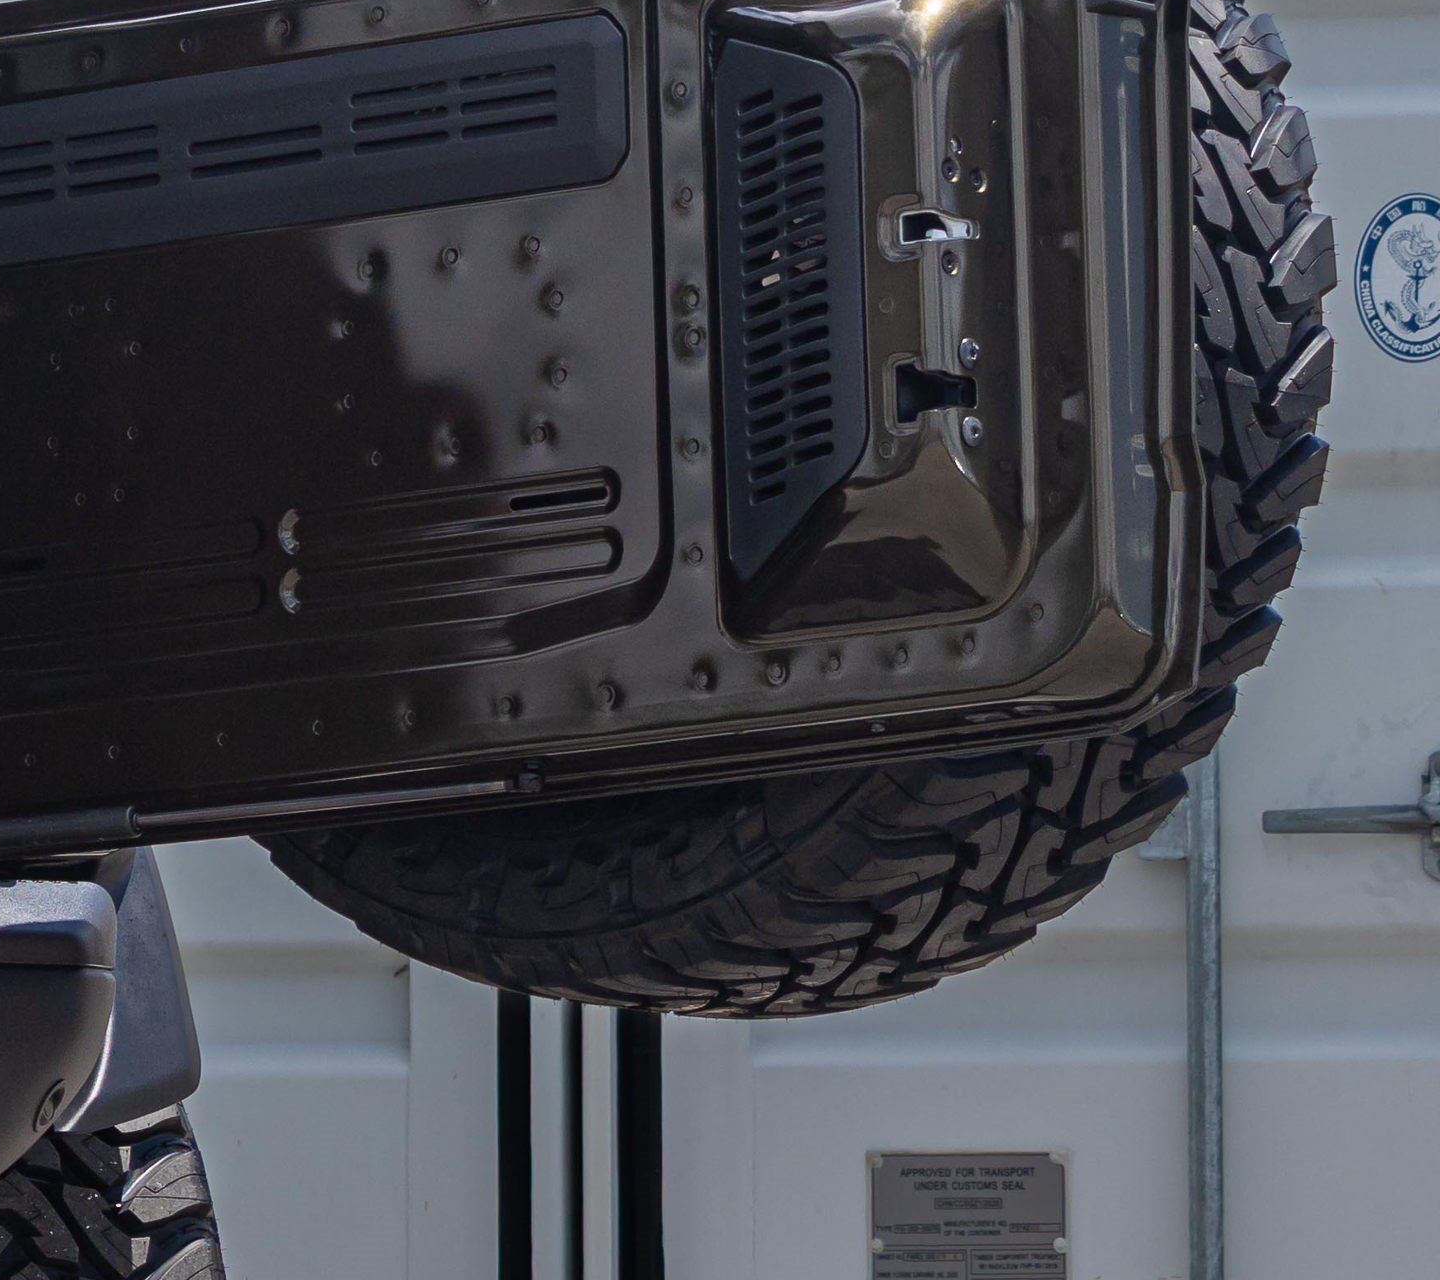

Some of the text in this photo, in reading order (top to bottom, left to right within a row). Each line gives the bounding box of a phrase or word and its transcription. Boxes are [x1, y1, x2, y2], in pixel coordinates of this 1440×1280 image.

[1360, 280, 1376, 318] CHINA
[900, 1166, 1035, 1177] APPROVED FOR TRANSPORT
[913, 1180, 1025, 1191] UNDER CUSTOMS SEAL
